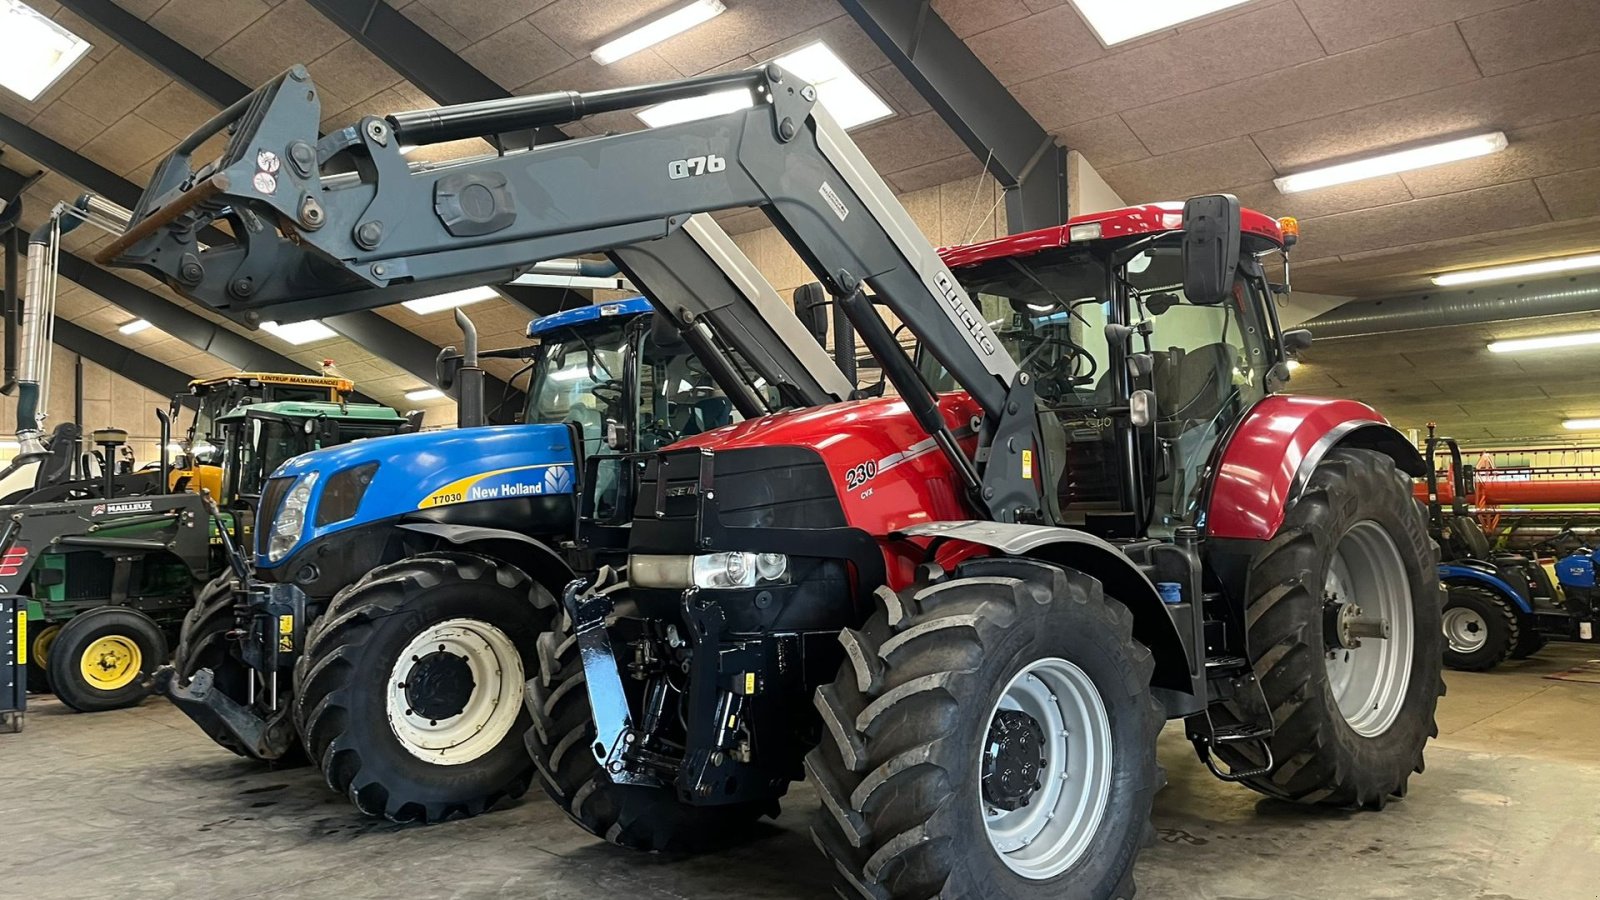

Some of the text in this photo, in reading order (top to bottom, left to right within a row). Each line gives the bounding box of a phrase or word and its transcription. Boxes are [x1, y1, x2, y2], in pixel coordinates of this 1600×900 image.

[668, 154, 726, 180] Q76
[934, 271, 995, 356] Quicke
[290, 377, 339, 385] MASKINHANDEL
[845, 460, 877, 491] 230
[432, 493, 462, 505] T7030
[472, 482, 542, 499] New Holland
[860, 488, 873, 500] CVX
